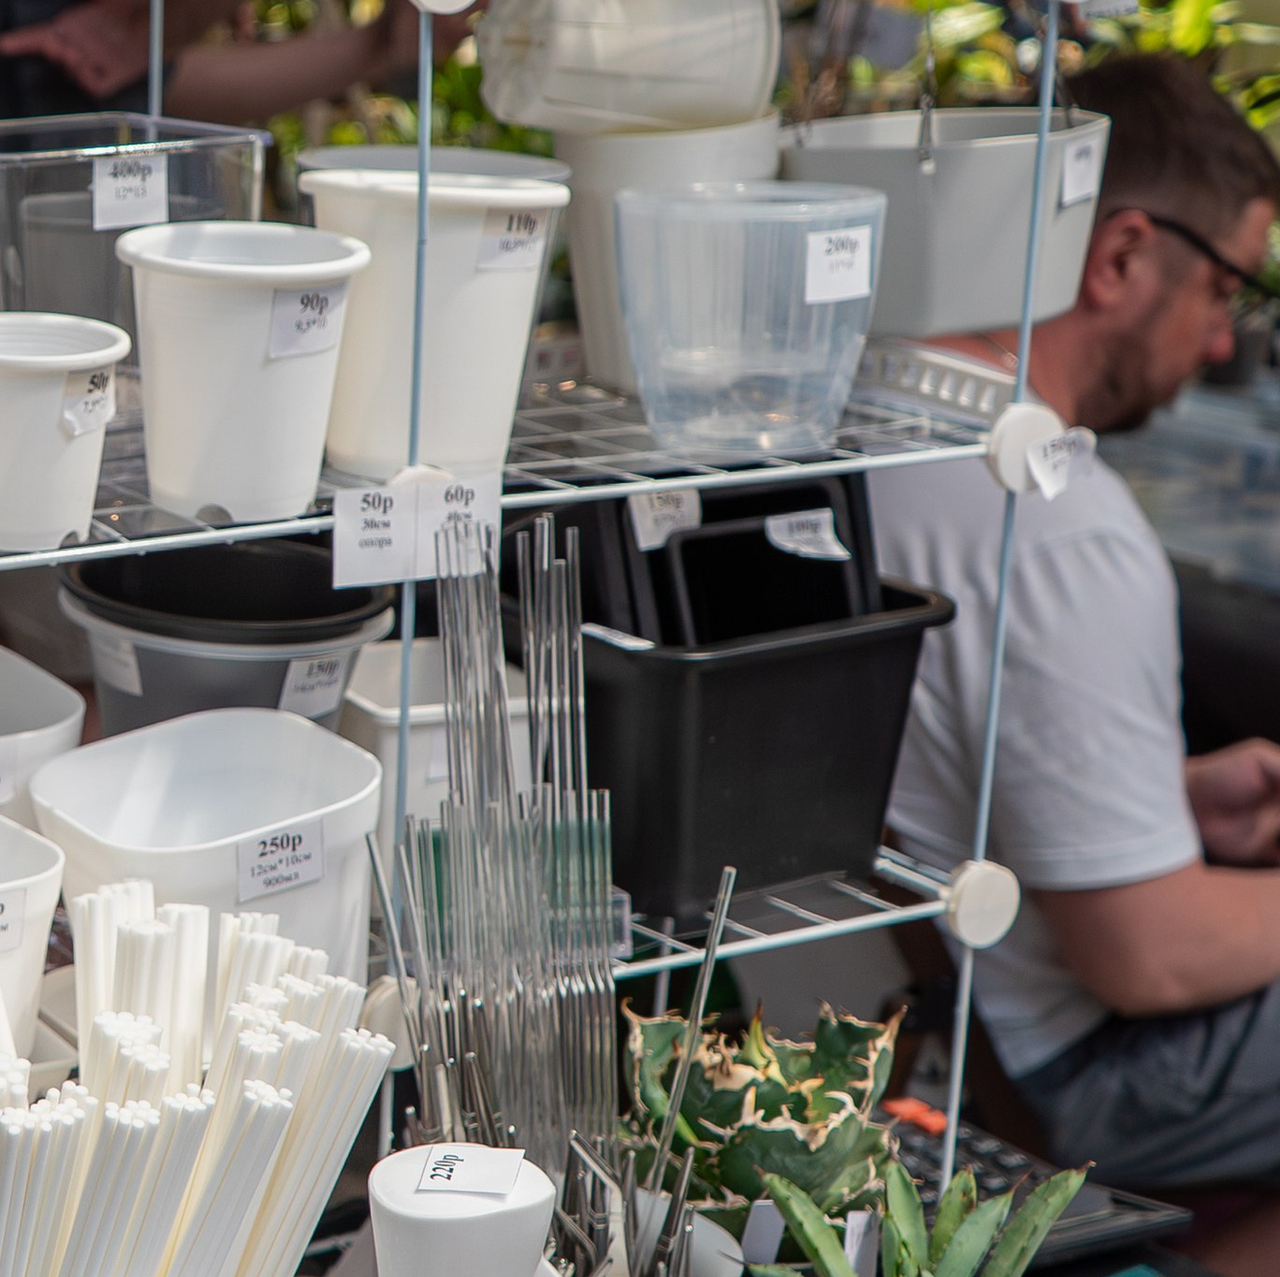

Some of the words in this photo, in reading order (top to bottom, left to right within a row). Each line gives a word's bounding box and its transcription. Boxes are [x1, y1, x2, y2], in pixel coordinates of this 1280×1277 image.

[299, 293, 329, 316] 90р
[362, 491, 393, 513] 50р
[444, 484, 474, 506] 60р
[258, 833, 303, 858] 250р
[429, 1153, 464, 1182] 220р
